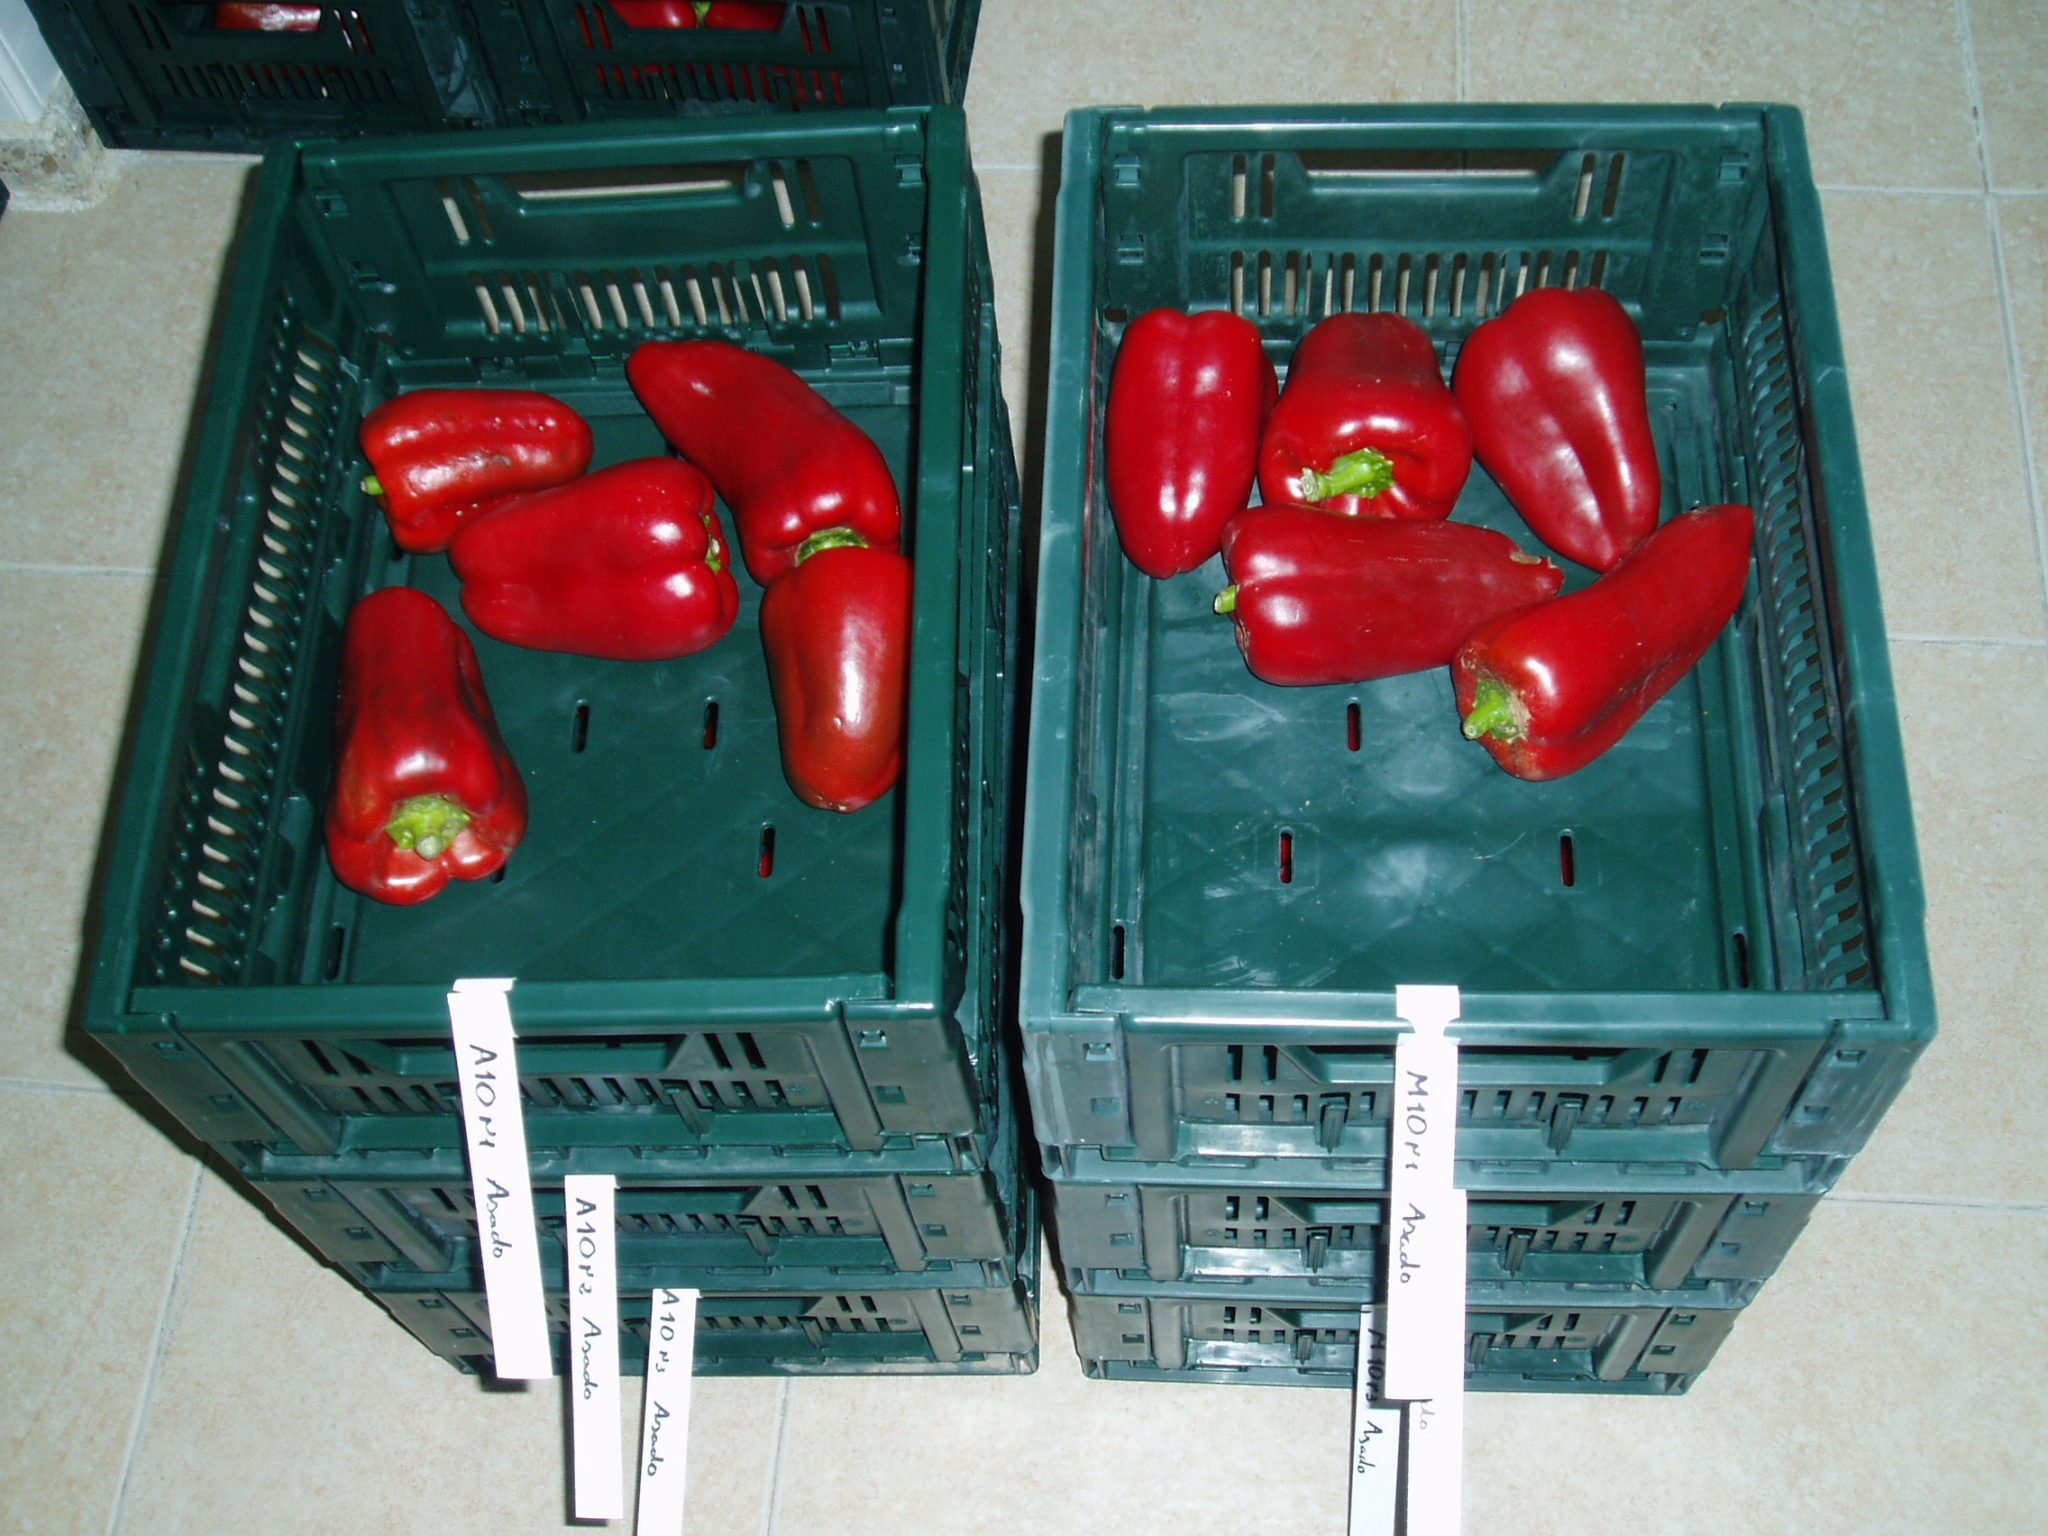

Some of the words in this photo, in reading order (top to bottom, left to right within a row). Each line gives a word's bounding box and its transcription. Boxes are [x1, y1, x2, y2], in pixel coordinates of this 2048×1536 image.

[486, 1177, 513, 1259] Asado
[1399, 1202, 1427, 1284] Asado
[581, 1316, 603, 1400] Asado
[647, 1400, 670, 1477] Asado
[1357, 1420, 1383, 1474] Asado
